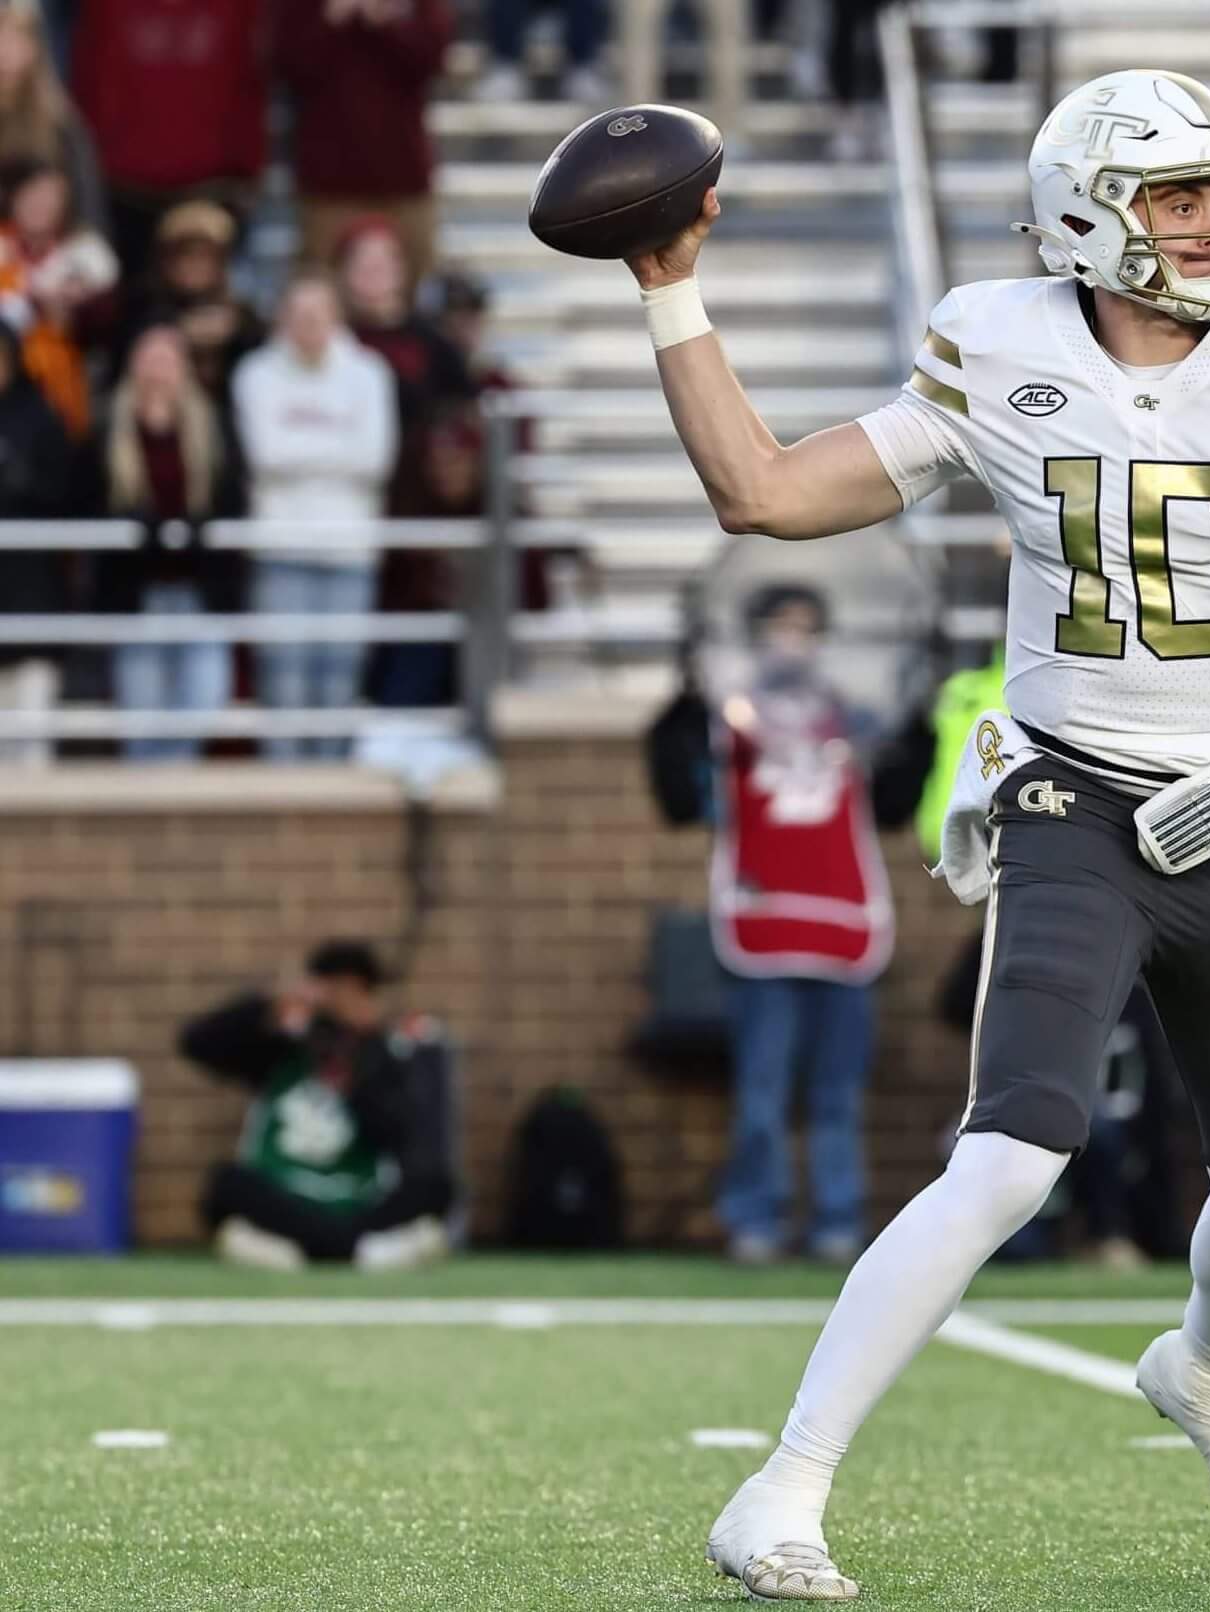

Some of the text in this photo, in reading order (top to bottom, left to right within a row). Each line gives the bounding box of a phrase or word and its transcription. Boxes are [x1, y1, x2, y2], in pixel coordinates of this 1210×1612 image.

[1047, 89, 1150, 160] GT
[1017, 391, 1059, 403] ACC
[1134, 394, 1160, 411] GT
[1017, 780, 1075, 816] GT
